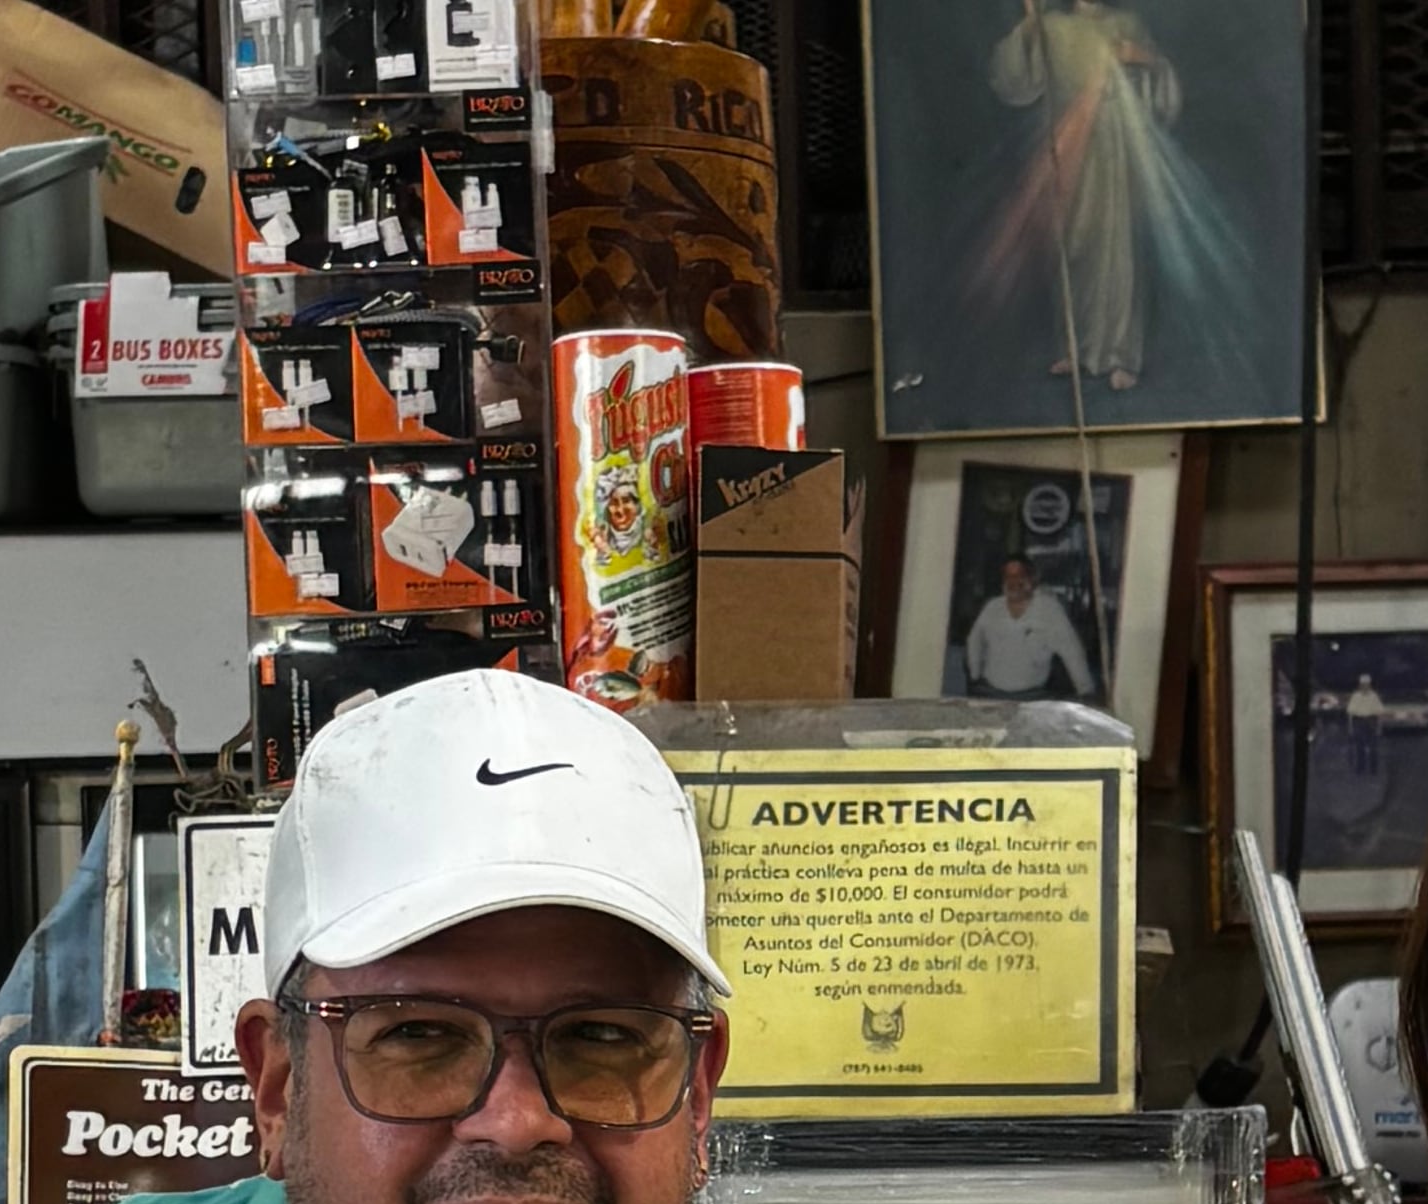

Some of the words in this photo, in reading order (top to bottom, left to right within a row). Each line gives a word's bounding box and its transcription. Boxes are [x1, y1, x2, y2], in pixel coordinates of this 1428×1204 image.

[89, 339, 102, 360] 2
[111, 339, 152, 361] BUS
[158, 338, 224, 360] BOXES
[751, 797, 1036, 827] ADVERTENCIA
[703, 842, 756, 857] ublicar
[761, 841, 834, 857] anuncios
[840, 839, 927, 859] engañosos
[933, 840, 949, 853] es
[1007, 836, 1071, 852] Incurrir
[1076, 839, 1098, 851] en
[704, 865, 719, 880] al
[724, 863, 790, 883] práctica
[795, 864, 863, 880] conlleva
[870, 864, 908, 881] pena
[914, 861, 934, 876] de
[940, 860, 986, 876] multa
[992, 860, 1012, 875] de
[1018, 860, 1061, 875] hasta
[1066, 863, 1089, 875] un
[716, 888, 784, 904] máximo
[790, 888, 810, 903] de
[893, 885, 908, 900] El
[913, 883, 1015, 900] consumidor
[1019, 882, 1069, 902] podrá
[705, 914, 765, 928] ometer
[806, 911, 873, 930] querella
[878, 911, 914, 925] ante
[919, 908, 934, 923] el
[940, 906, 1063, 926] Departamento
[1069, 906, 1090, 922] de
[743, 935, 813, 951] Asuntos
[818, 933, 843, 949] del
[849, 932, 955, 949] Consumidor
[743, 959, 772, 979] Ley
[778, 957, 824, 974] Núm.
[830, 956, 841, 973] 5
[846, 957, 867, 973] de
[873, 955, 893, 973] 23
[899, 955, 919, 972] de
[925, 954, 962, 971] abril
[967, 954, 988, 971] de
[814, 980, 862, 1000] según
[141, 1079, 195, 1102] The
[61, 1110, 254, 1158] Pocket
